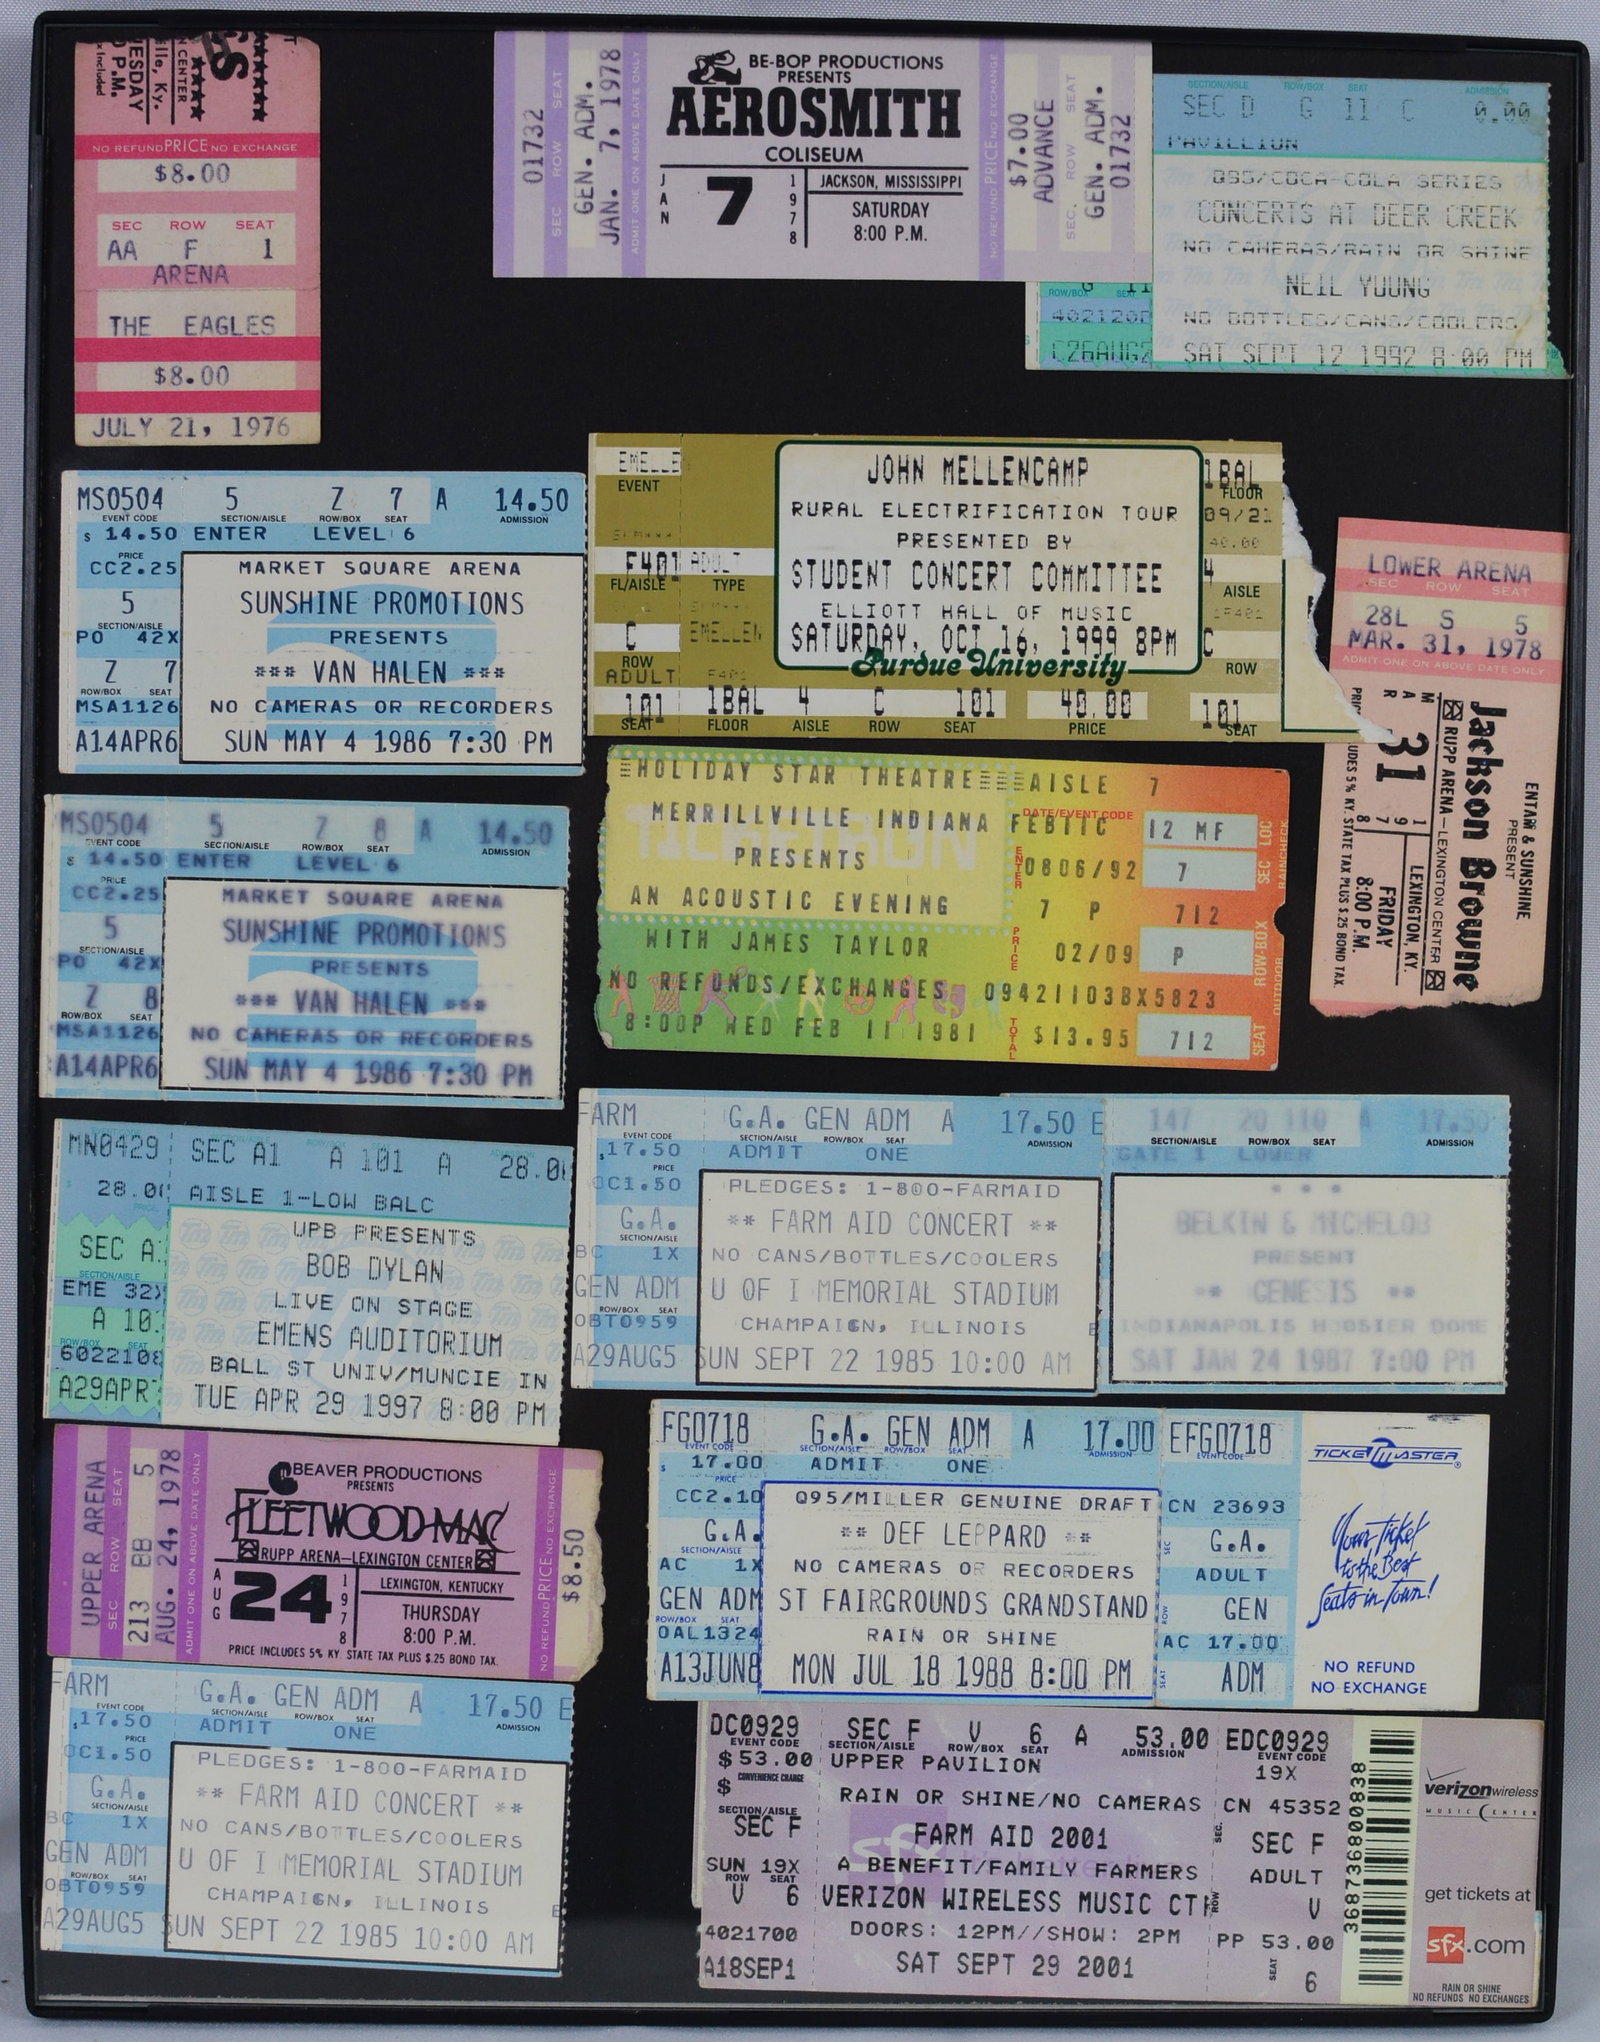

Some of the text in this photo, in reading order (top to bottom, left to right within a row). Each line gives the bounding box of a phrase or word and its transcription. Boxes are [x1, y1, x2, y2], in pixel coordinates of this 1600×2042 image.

[749, 54, 944, 70] BE-BOP PRODUCTIONS
[777, 71, 852, 84] PRESENTS
[666, 86, 961, 138] AEROSMITH
[522, 108, 544, 185] 01732
[765, 146, 863, 163] COLISEUM
[1008, 113, 1029, 186] $7.00
[1033, 100, 1054, 203] ADVANCE
[154, 163, 231, 184] $8.00
[820, 174, 961, 190] JACKSON, MISSISSIPPI
[707, 176, 753, 225] 7
[852, 202, 929, 218] SATURDAY
[111, 219, 274, 231] SEC ROW SEAT
[1197, 200, 1517, 228] CONCERTS AT DEER CREEK
[854, 225, 927, 241] 8:00 P.M.
[107, 239, 273, 261] AA F 1
[153, 265, 229, 285] ARENA
[1286, 274, 1342, 297] NEIL
[109, 315, 276, 337] THE EAGLES
[155, 366, 230, 386] $8.00
[93, 417, 290, 439] JULY 21, 1976
[867, 454, 1089, 487] JOHN MELLENCAMP
[77, 486, 164, 511] MS0504
[496, 487, 569, 512] 14.50
[791, 501, 1178, 522] RURAL ELECTRIFICATION TOUR
[897, 533, 1073, 550] PRESENTED BY
[239, 561, 521, 576] MARKET SQUARE ARENA
[791, 559, 1162, 593] STUDENT CONCERT COMMITTEE
[1368, 553, 1532, 583] LOWER ARENA
[240, 591, 524, 615] SUNSHINE PROMOTIONS
[330, 631, 448, 645] PRESENTS
[1348, 628, 1542, 660] MAR. 31, 1978
[313, 661, 446, 684] VAN HALEN
[850, 648, 1127, 687] Purdue University
[1069, 722, 1106, 735] PRICE
[225, 730, 552, 753] SUN MAY 4 1986 7:30 PM
[637, 759, 973, 789] HOLIDAY STAR THEATRE
[734, 847, 865, 870] PRESENTS
[1453, 701, 1508, 993] Jackson Browne
[631, 885, 949, 915] AN ACOUSTIC EVENING
[1352, 876, 1374, 953] 8:00 P.M.
[1376, 886, 1397, 948] FRIDAY
[647, 929, 929, 957] WITH JAMES TAYLOR
[294, 990, 428, 1016] VAN HALEN
[1034, 1026, 1128, 1048] $13.95
[1001, 1110, 1075, 1135] 17.50
[1027, 1140, 1072, 1148] ADMISSION
[1248, 1138, 1474, 1147] ROW/BOX SEAT ADMISSION
[293, 1221, 476, 1246] UPB PRESENTS
[772, 1210, 1013, 1237] FARM AID CONCERT
[307, 1253, 444, 1283] BOB DYLAN
[1253, 1251, 1356, 1264] PRESENT
[275, 1292, 473, 1318] LIVE ON STAGE
[258, 1321, 502, 1357] EMENS AUDITORIUM
[293, 1463, 482, 1484] BEAVER PRODUCTIONS
[347, 1481, 394, 1492] PRESENTS
[884, 1521, 1046, 1549] DEF LEPPARD
[562, 1529, 585, 1603] $8.50
[380, 1577, 504, 1594] LEXINGTON, KENTUCKY
[230, 1571, 333, 1624] 24
[403, 1604, 480, 1623] THURSDAY
[403, 1627, 476, 1646] 8:00 P.M.
[867, 1628, 1057, 1647] RAIN OR SHINE
[792, 1653, 1131, 1690] MON JUL 18 1988 8:00 PM
[1324, 1661, 1415, 1673] NO REFUND
[1311, 1682, 1427, 1695] NO EXCHANGE
[831, 1754, 1041, 1773] UPPER PAVILION
[240, 1783, 479, 1818] FARM AID CONCERT
[914, 1823, 1108, 1850] FARM AID 2001
[1344, 1762, 1366, 1933] 368736800838
[1425, 1887, 1531, 1902] get tickets at
[897, 1952, 1134, 1979] SAT SEPT 29 2001
